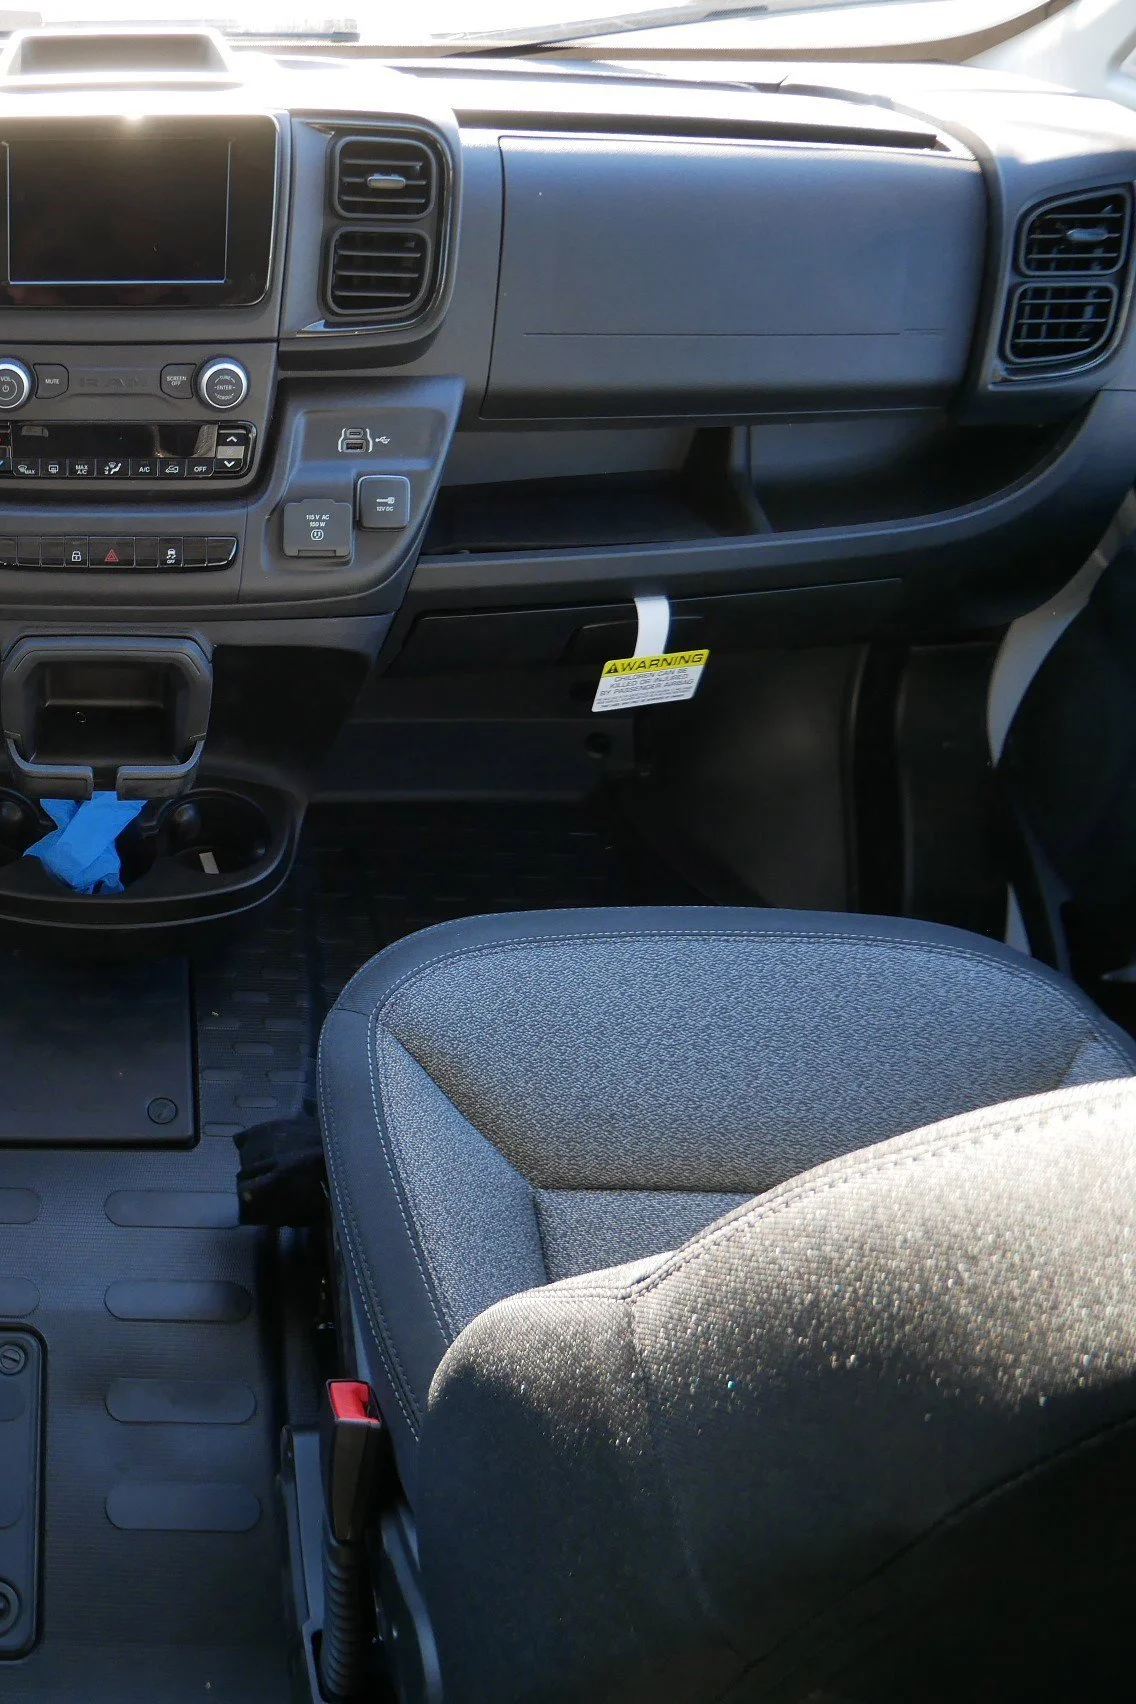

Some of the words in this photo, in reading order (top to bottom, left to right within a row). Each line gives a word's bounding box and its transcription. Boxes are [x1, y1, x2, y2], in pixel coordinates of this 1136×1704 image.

[620, 653, 704, 672] WARNING
[609, 680, 638, 688] KILLED
[639, 677, 652, 685] OR
[653, 673, 689, 683] INJURED
[614, 672, 655, 682] CHILDREN
[657, 669, 675, 677] CAN
[599, 689, 612, 697] BY
[613, 683, 662, 693] PASSENGER
[663, 678, 694, 688] AIRBAG
